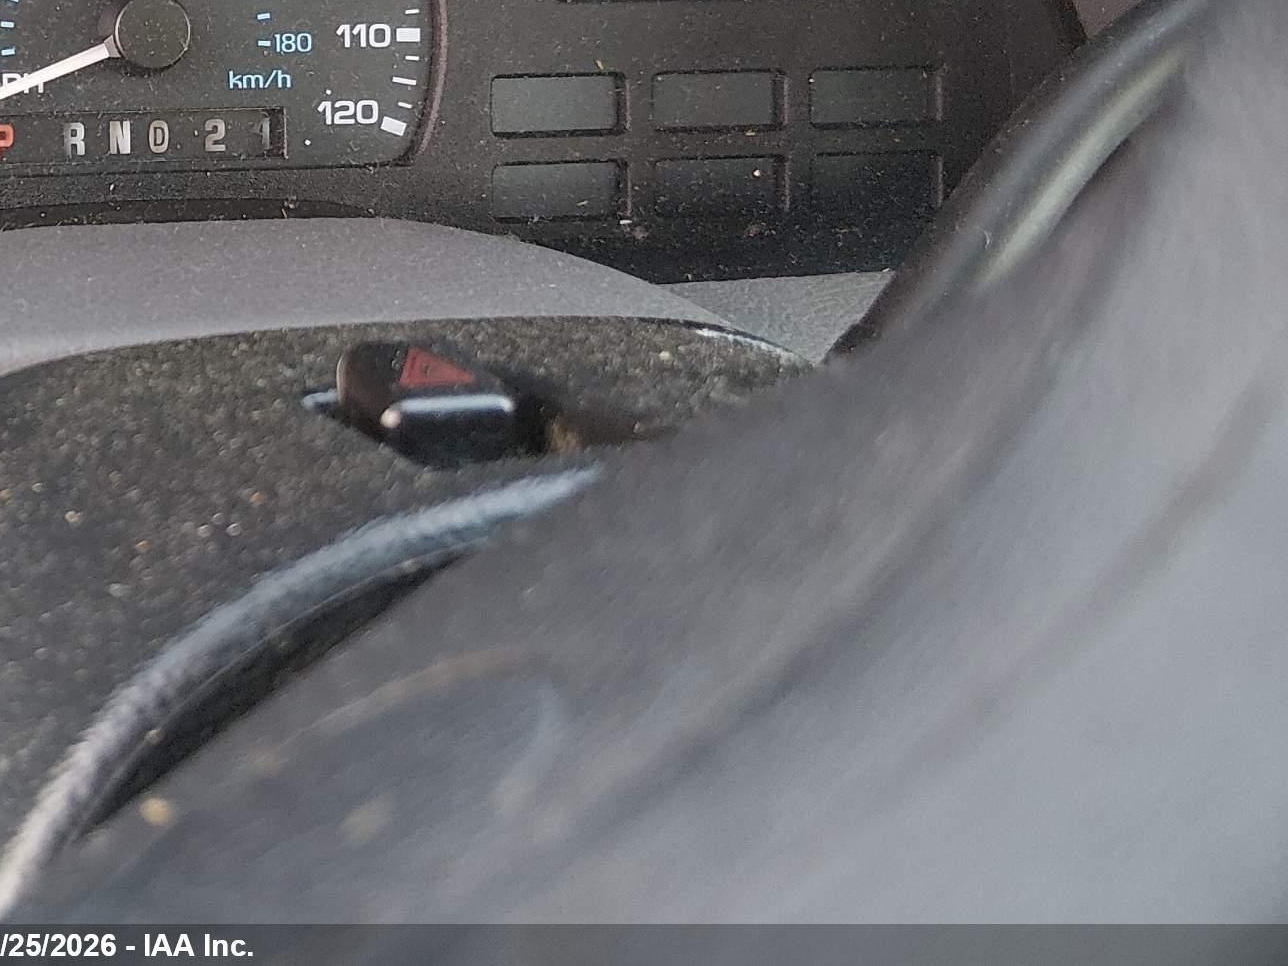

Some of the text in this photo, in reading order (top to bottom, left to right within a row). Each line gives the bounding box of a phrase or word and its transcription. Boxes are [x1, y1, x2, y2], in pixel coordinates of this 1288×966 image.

[273, 33, 312, 53] 180
[336, 23, 392, 48] 110
[228, 70, 292, 89] km/h
[317, 100, 379, 125] 120
[64, 122, 86, 156] R
[109, 120, 131, 155] N
[204, 119, 227, 152] 2
